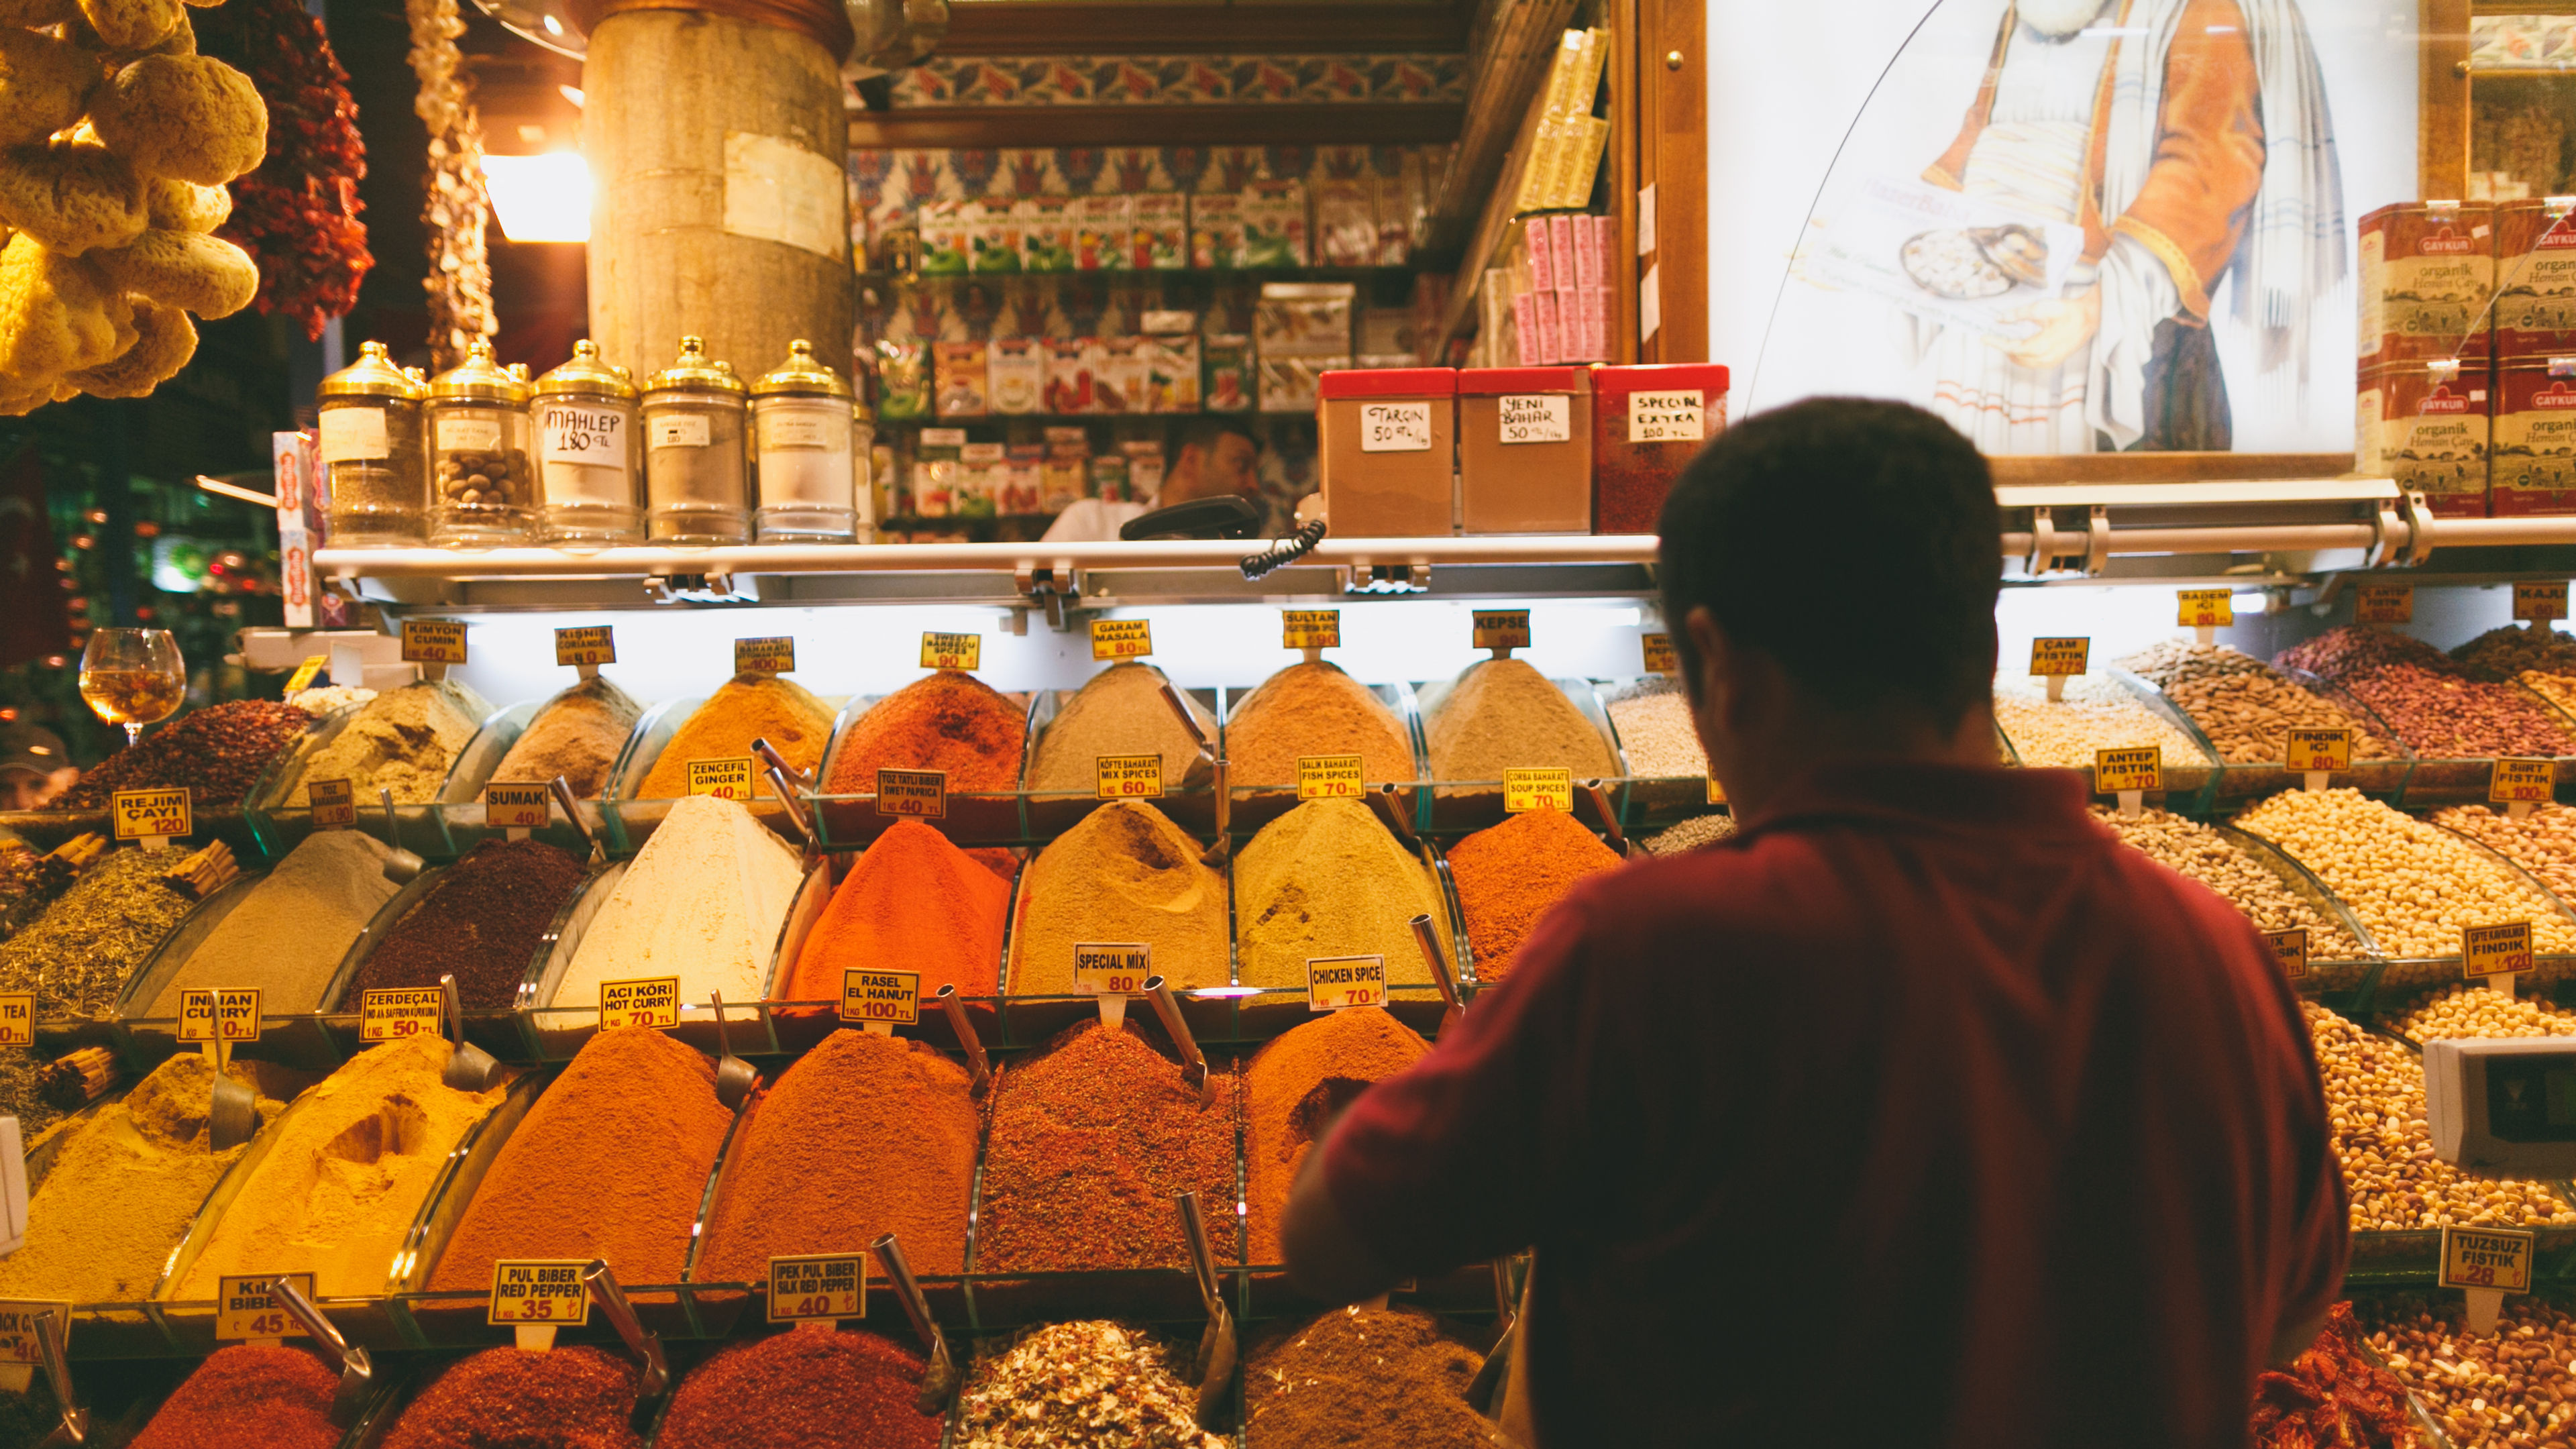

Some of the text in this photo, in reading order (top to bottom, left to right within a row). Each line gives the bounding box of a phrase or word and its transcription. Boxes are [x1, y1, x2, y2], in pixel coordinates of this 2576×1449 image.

[1638, 396, 1701, 408] SPECIAL
[547, 411, 620, 432] MAHLEP
[1500, 410, 1557, 424] BAHAR
[1638, 413, 1696, 424] EXTRA
[1375, 427, 1393, 441] 50
[1509, 427, 1528, 439] 50
[1642, 427, 1664, 438] 100
[2416, 422, 2468, 437] organik
[557, 431, 590, 451] 180
[2182, 592, 2229, 600] BADEM
[1287, 612, 1336, 622] SULTAN
[1476, 616, 1527, 629] KEPSE
[1099, 622, 1143, 632] GARAM
[1094, 631, 1148, 642] MASALA
[1317, 634, 1338, 646] 90
[423, 646, 445, 659] 40
[1116, 642, 1136, 654] 80
[939, 653, 959, 667] 90
[2035, 652, 2084, 660] FISTIK
[2294, 733, 2345, 742] FINDIK
[1124, 759, 1159, 769] BAHARATI
[2106, 752, 2153, 763] ANTEP
[2312, 757, 2333, 769] 80
[1301, 759, 1359, 770] BALIK BAHARATI
[2102, 763, 2155, 775] FISTIK
[695, 773, 745, 785] GINGER
[882, 774, 896, 784] TOZ
[1102, 769, 1157, 779] MIX SPICES
[1302, 769, 1359, 780] FISH SPICES
[1509, 772, 1567, 784] ÇORBA BAHARATI
[2499, 774, 2549, 784] FISTIK
[1122, 781, 1145, 794] 60
[2132, 775, 2155, 788] 70
[711, 786, 734, 799] 40
[884, 786, 937, 798] SWET PAPRICA
[1324, 782, 1346, 795] 70
[1510, 784, 1566, 793] SOUP SPICES
[2513, 786, 2539, 800] 100
[489, 791, 544, 805] SUMAK
[1533, 796, 1553, 807] 70
[899, 799, 922, 814] 40
[127, 808, 178, 821] ÇAYI
[335, 806, 350, 821] 90
[515, 811, 535, 825] 40
[151, 818, 184, 833] 120
[2473, 940, 2524, 955] FINDIK
[1078, 953, 1123, 970] SPECIAL
[2504, 953, 2532, 969] 120
[861, 976, 902, 988] RASEL
[1313, 966, 1381, 985] CHICKEN SPICE
[1109, 977, 1134, 991] 80
[607, 986, 633, 998] ACI
[848, 987, 914, 1001] EL HANUT
[1345, 989, 1371, 1004] 70
[368, 993, 438, 1006] ZERDEÇAL
[604, 996, 673, 1010] HOT CURRY
[3, 1005, 27, 1019] TEA
[366, 1007, 437, 1019] INDAN SAFFRON KURKUMA
[861, 1002, 912, 1018] 100 TL
[629, 1012, 654, 1026] 70
[658, 1015, 672, 1024] TL
[372, 1027, 383, 1036] KG
[392, 1020, 419, 1036] 50
[13, 1033, 28, 1042] TL
[2457, 1236, 2522, 1254] TUZSUZ
[2461, 1251, 2515, 1268] FISTIK
[508, 1269, 534, 1283] PUL
[803, 1264, 823, 1279] PUL
[2465, 1265, 2495, 1286] 28
[500, 1283, 581, 1298] RED PEPPER
[800, 1279, 820, 1294] RED
[821, 1277, 855, 1293] PEPPER
[230, 1296, 280, 1310] BiBE
[521, 1299, 552, 1318] 35
[797, 1295, 830, 1314] 40
[250, 1313, 284, 1334] 45
